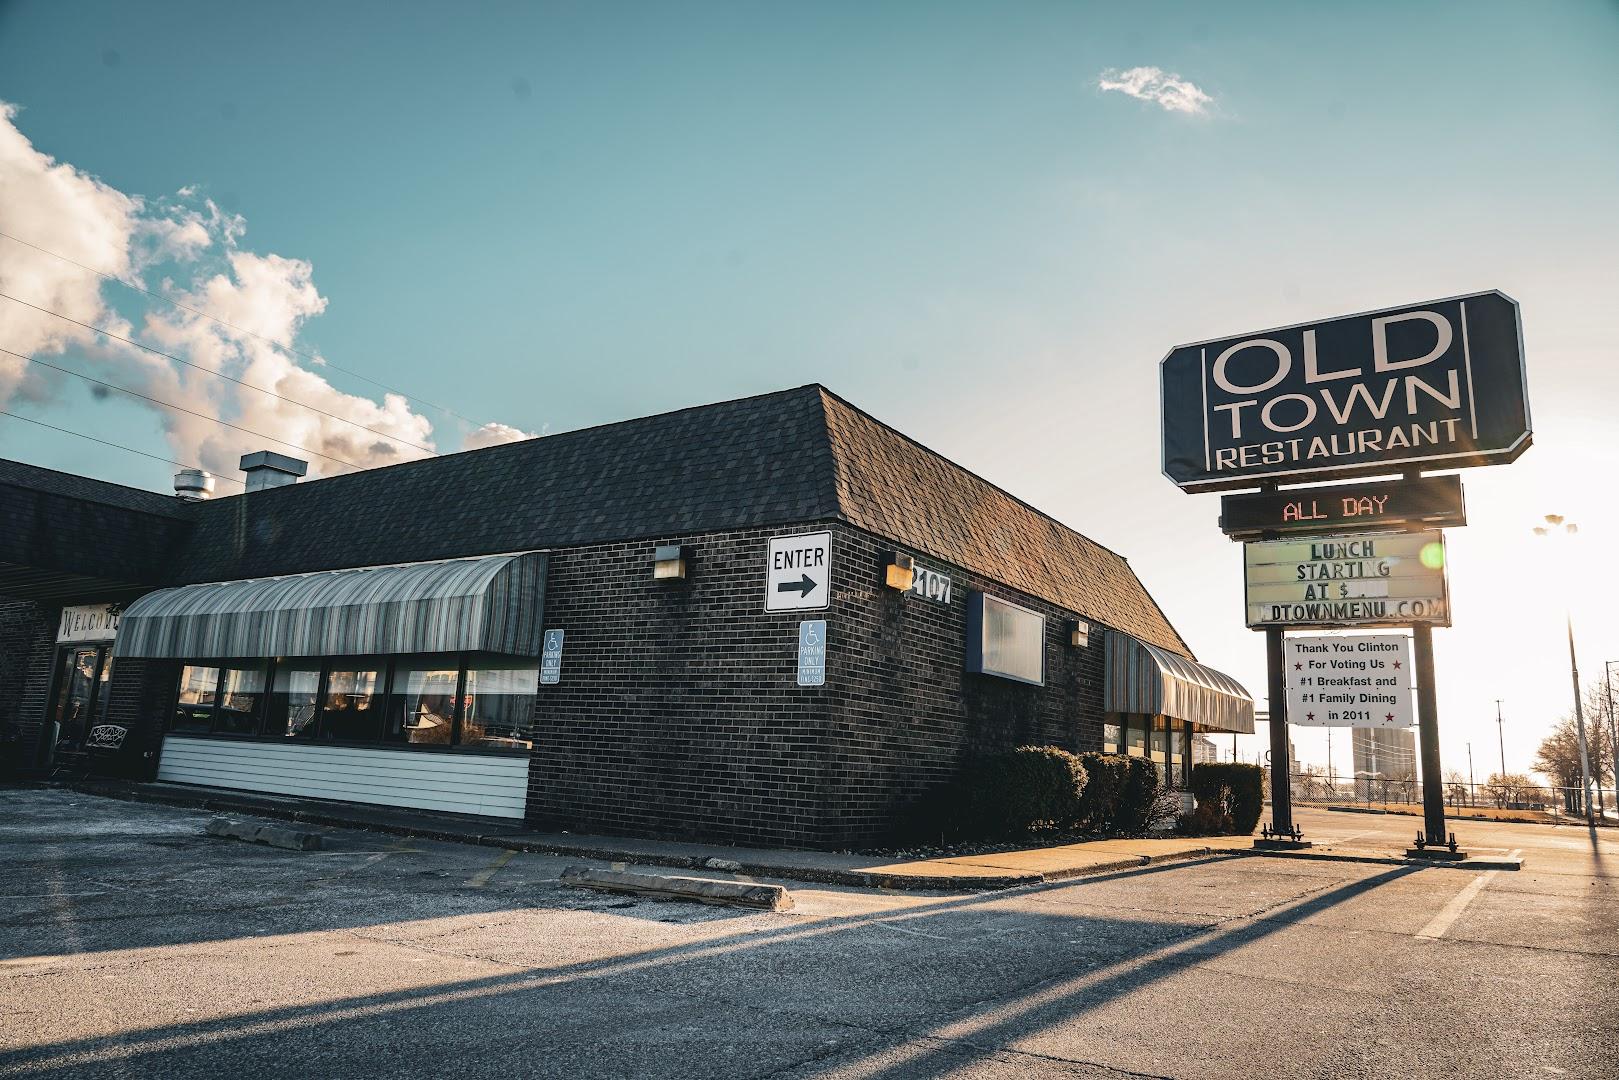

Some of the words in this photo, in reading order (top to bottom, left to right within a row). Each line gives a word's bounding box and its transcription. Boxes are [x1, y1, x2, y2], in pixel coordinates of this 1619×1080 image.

[1212, 310, 1453, 395] OLD
[1213, 369, 1461, 440] TOWN
[1216, 418, 1462, 471] RESTAURANT
[1283, 500, 1328, 521] ALL
[1342, 494, 1388, 517] DAY
[1311, 541, 1374, 560] LUNCH
[774, 547, 824, 570] ENTER
[1305, 583, 1329, 600] AT
[800, 645, 824, 656] PARKING
[1295, 643, 1329, 653] Thank
[1332, 643, 1354, 652] You
[1357, 642, 1399, 652] Clinton
[805, 656, 820, 666] ONLY
[1308, 660, 1327, 669] For
[1330, 660, 1366, 670] Voting
[1370, 660, 1385, 669] Us
[1300, 677, 1312, 686] #1
[1317, 676, 1372, 686] Breakfast
[1375, 677, 1397, 686] and
[1302, 694, 1314, 703] #1
[1319, 693, 1356, 704] Family
[1359, 693, 1397, 704] Dining
[1328, 711, 1339, 720] in
[1342, 711, 1370, 720] 2011
